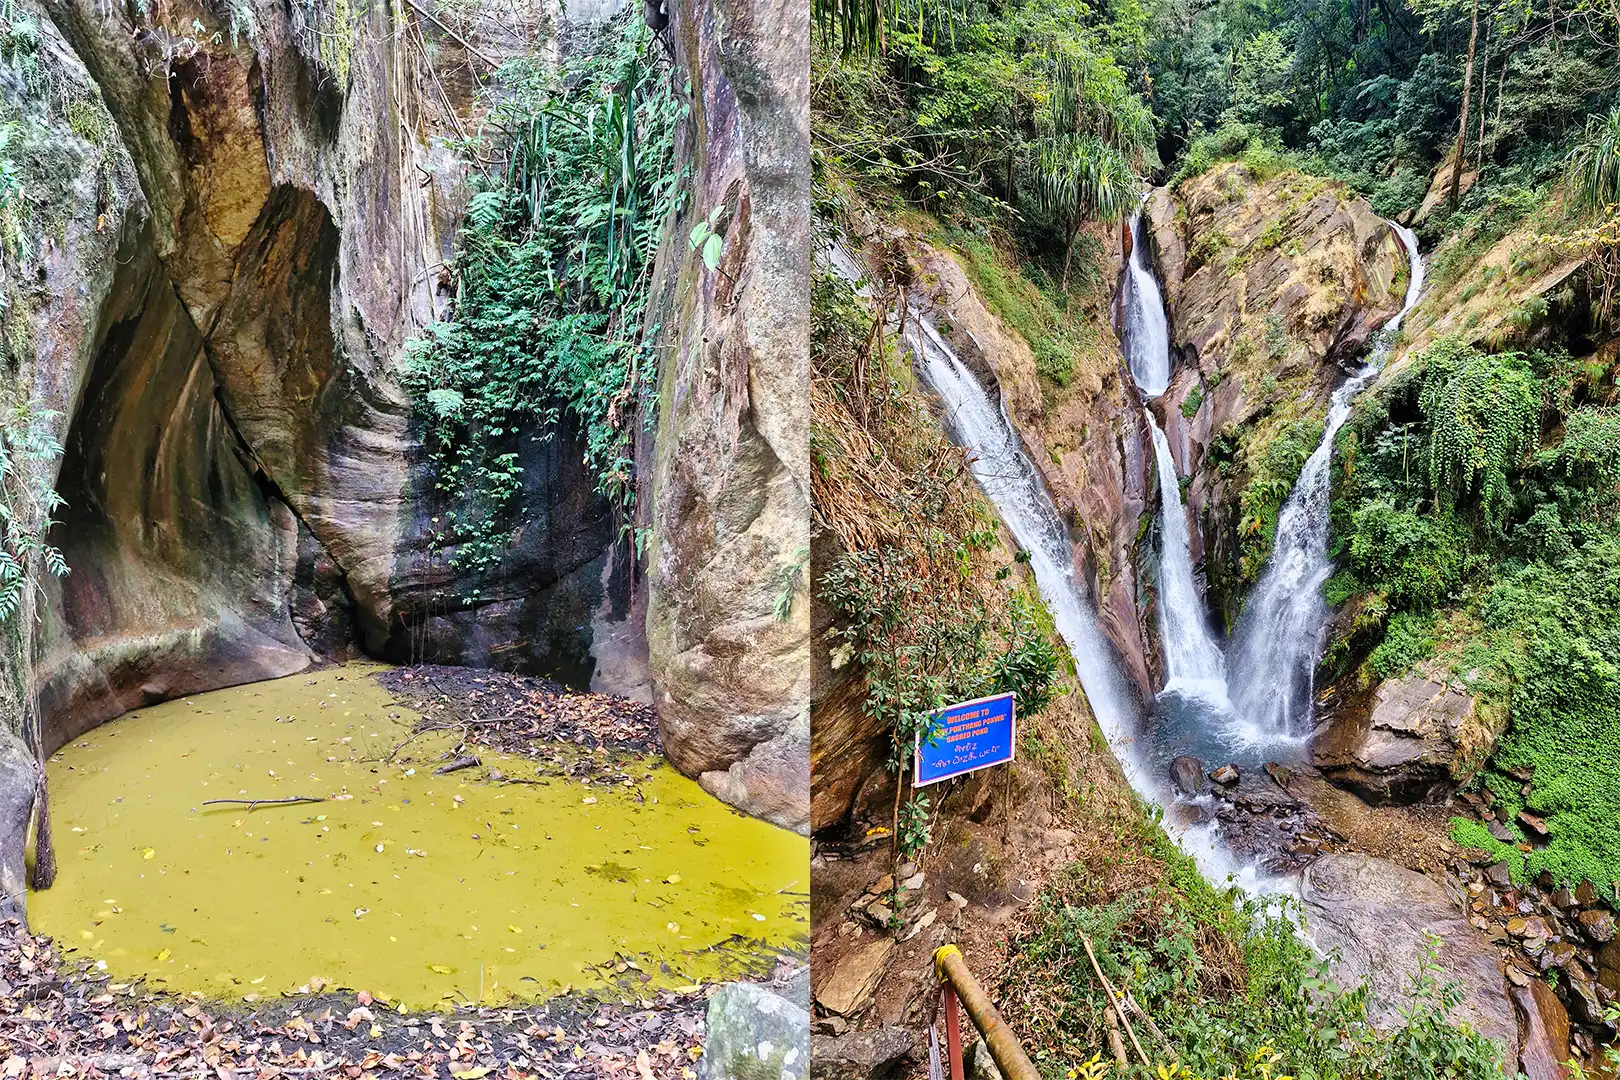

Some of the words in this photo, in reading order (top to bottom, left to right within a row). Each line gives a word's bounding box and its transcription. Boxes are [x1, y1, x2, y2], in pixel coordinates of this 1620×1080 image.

[947, 710, 980, 724] WELCOME
[981, 708, 989, 717] TO
[946, 732, 970, 743] SACRED
[971, 727, 988, 737] POND
